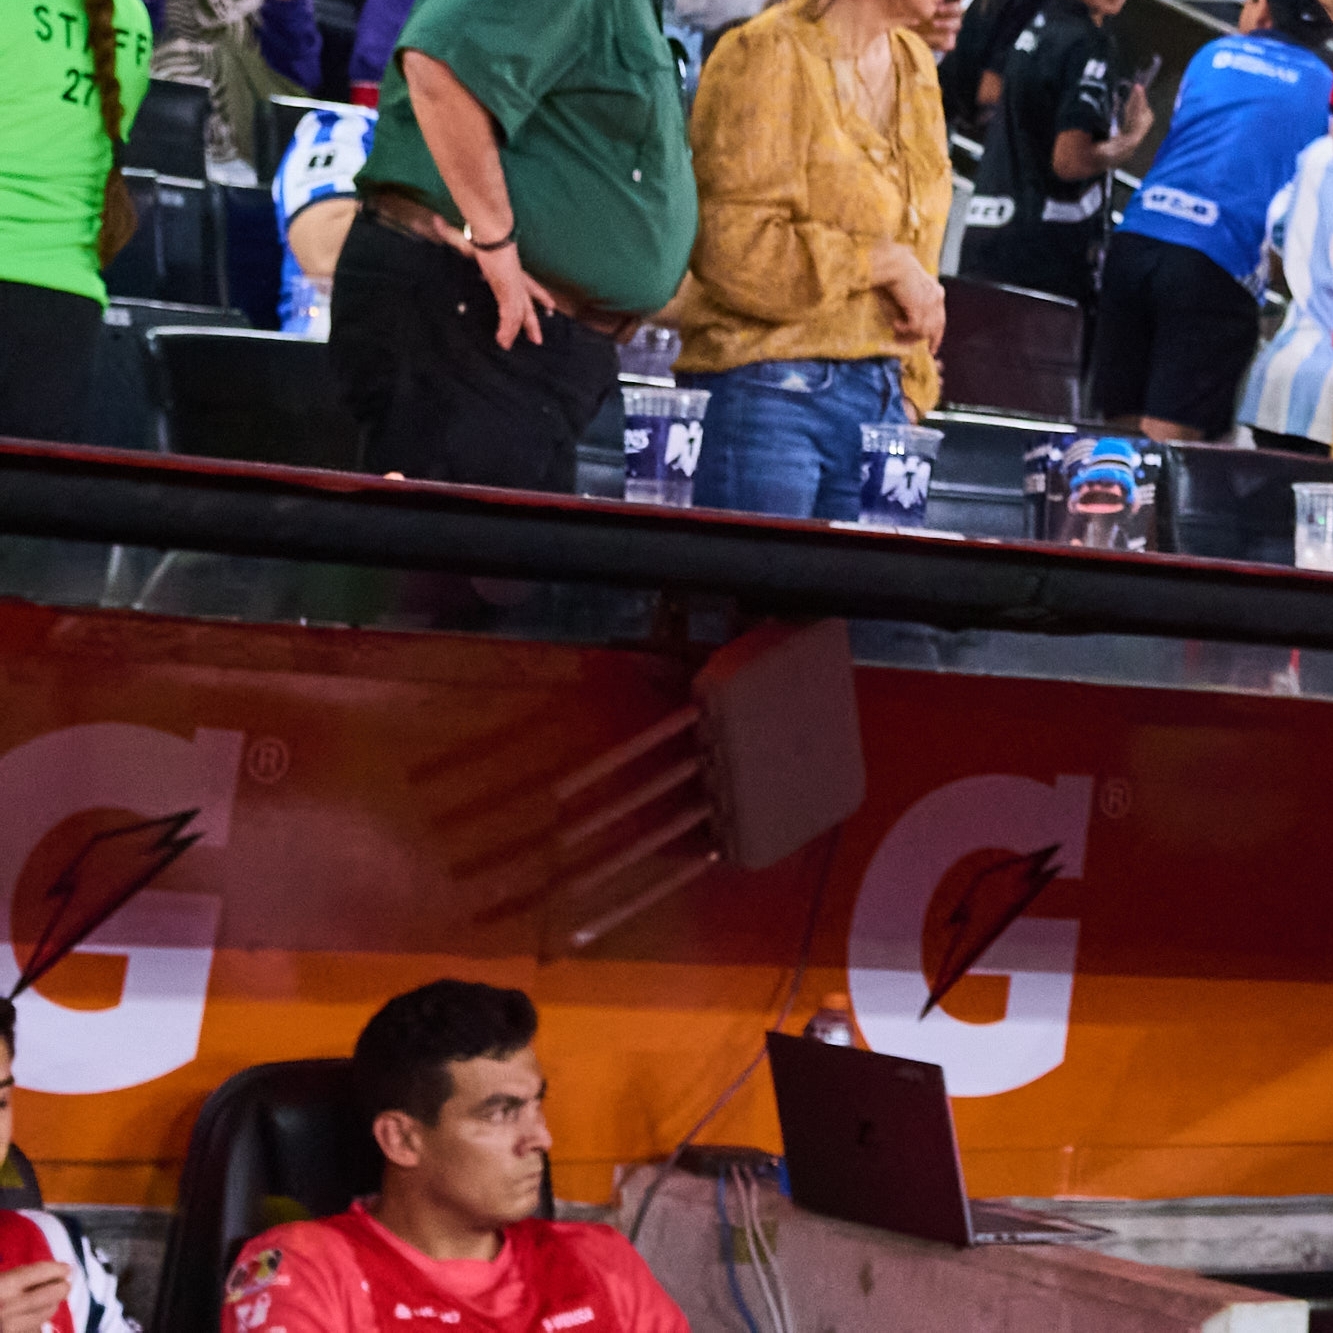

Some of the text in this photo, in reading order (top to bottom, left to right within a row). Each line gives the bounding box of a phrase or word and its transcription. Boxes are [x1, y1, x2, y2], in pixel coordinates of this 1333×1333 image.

[34, 4, 147, 66] STFF
[62, 68, 96, 107] 27
[0, 722, 245, 1095] G
[847, 773, 1094, 1097] G
